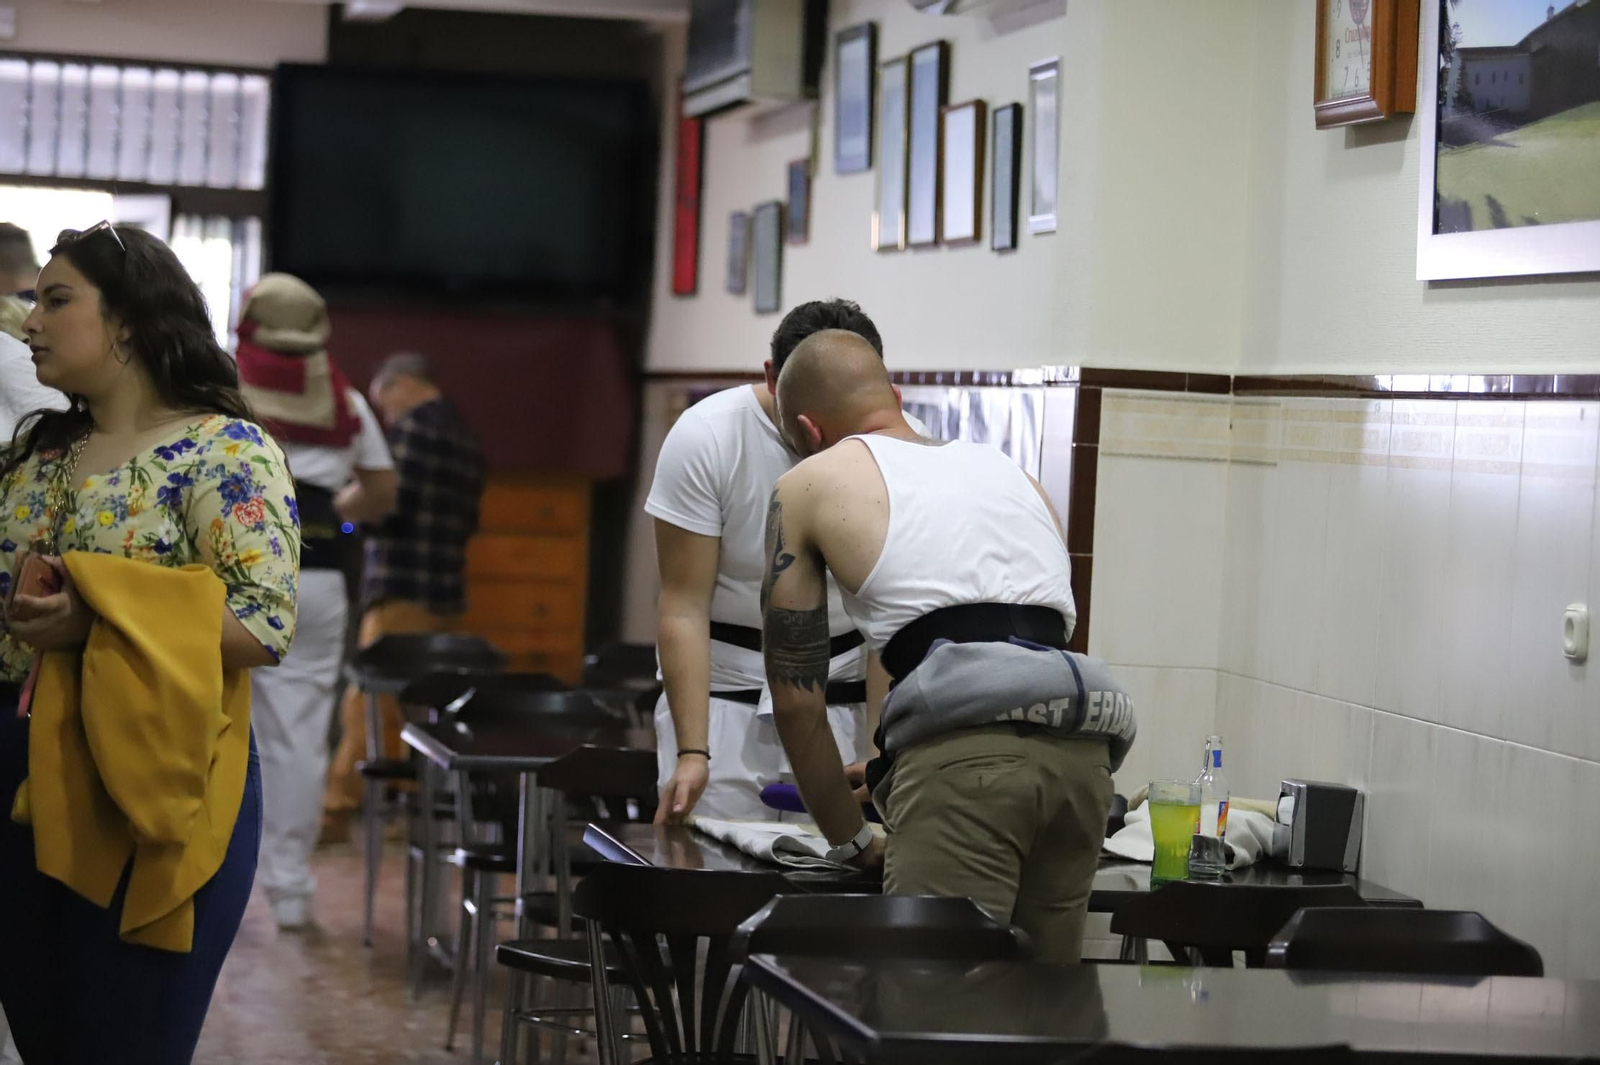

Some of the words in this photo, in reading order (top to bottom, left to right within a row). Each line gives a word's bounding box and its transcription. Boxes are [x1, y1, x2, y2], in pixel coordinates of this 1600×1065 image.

[1336, 39, 1340, 59] 8
[1344, 66, 1349, 87] 7
[1355, 68, 1359, 88] 6
